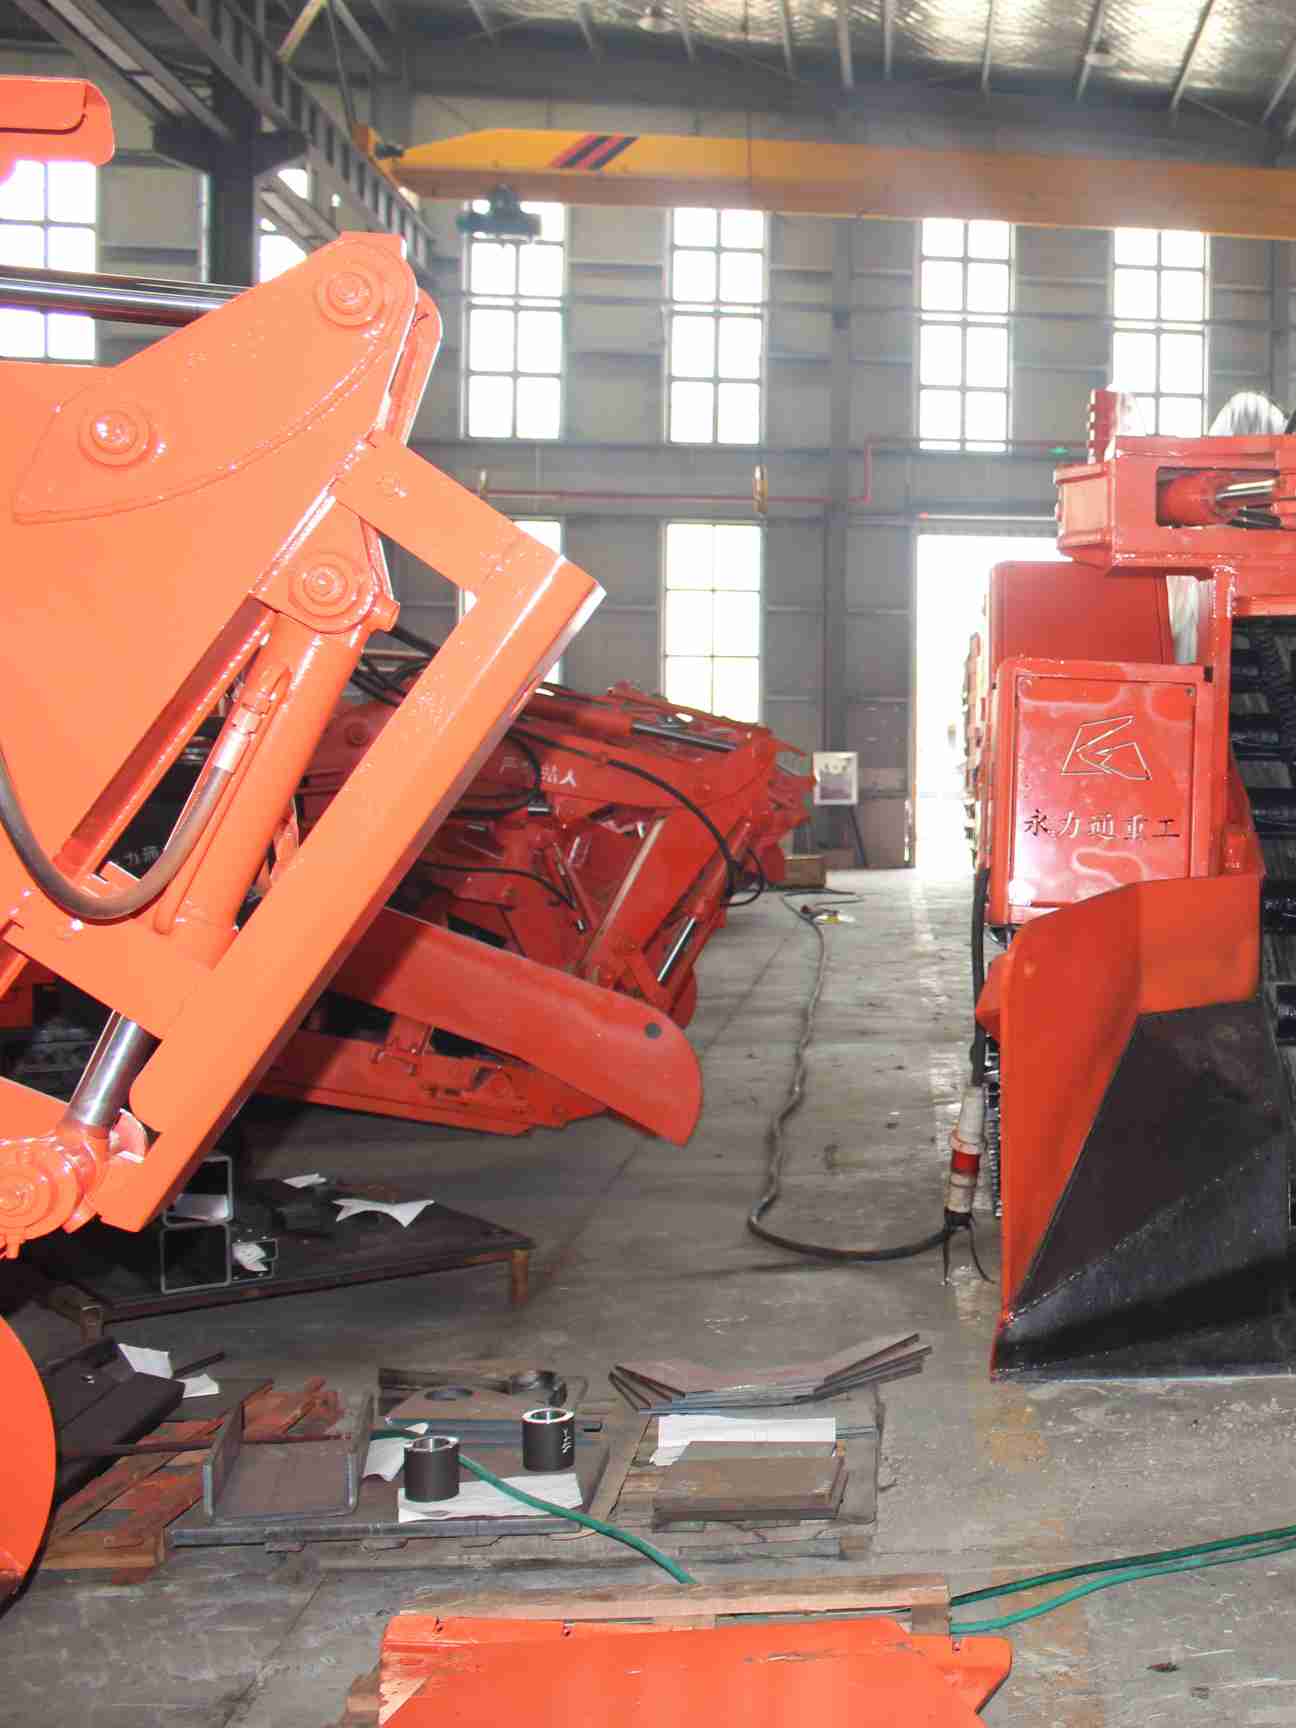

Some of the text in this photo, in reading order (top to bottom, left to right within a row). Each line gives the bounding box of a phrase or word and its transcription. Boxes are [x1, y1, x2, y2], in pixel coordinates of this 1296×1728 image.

[1024, 809, 1180, 840] 永力通重工
